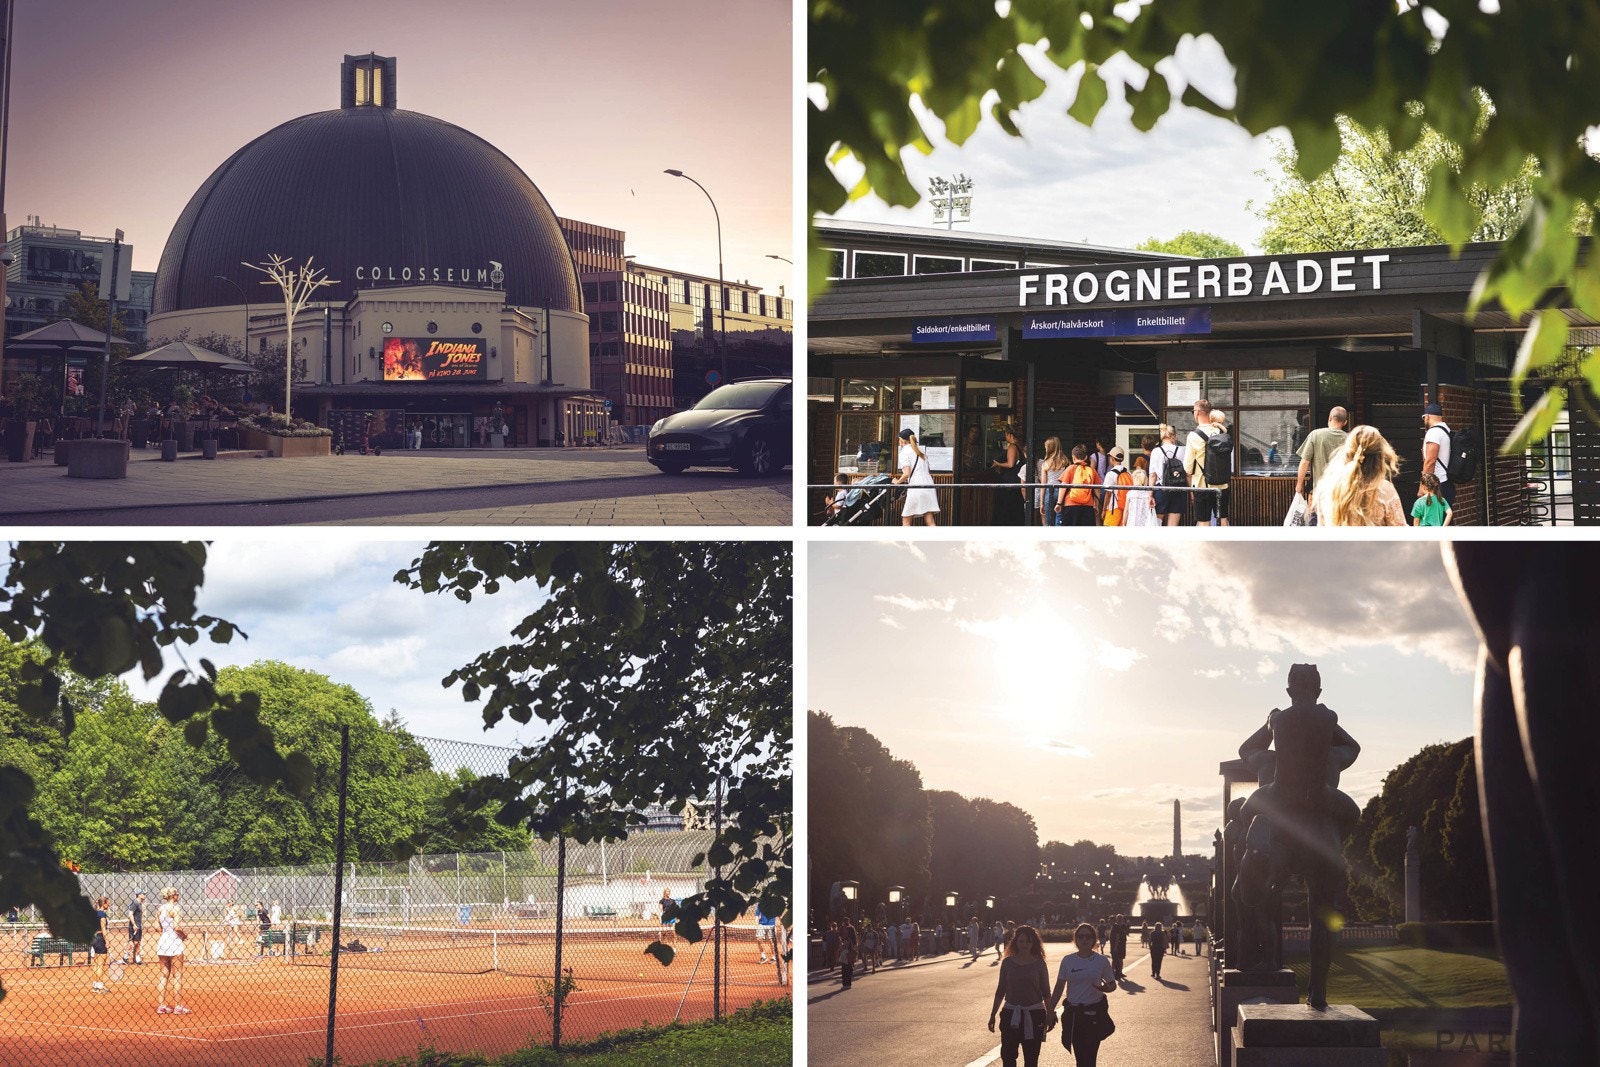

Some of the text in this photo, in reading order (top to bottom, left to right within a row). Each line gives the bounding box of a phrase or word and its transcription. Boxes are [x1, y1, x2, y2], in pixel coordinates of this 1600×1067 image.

[356, 266, 487, 283] COLOSSEUM
[1019, 254, 1390, 306] FROGNERBADET
[1031, 319, 1104, 331] Årskort/halvårskort
[1136, 316, 1186, 327] Enkeltbillett
[916, 323, 990, 335] Saldokort/enkeltbillett
[440, 352, 482, 367] JONES
